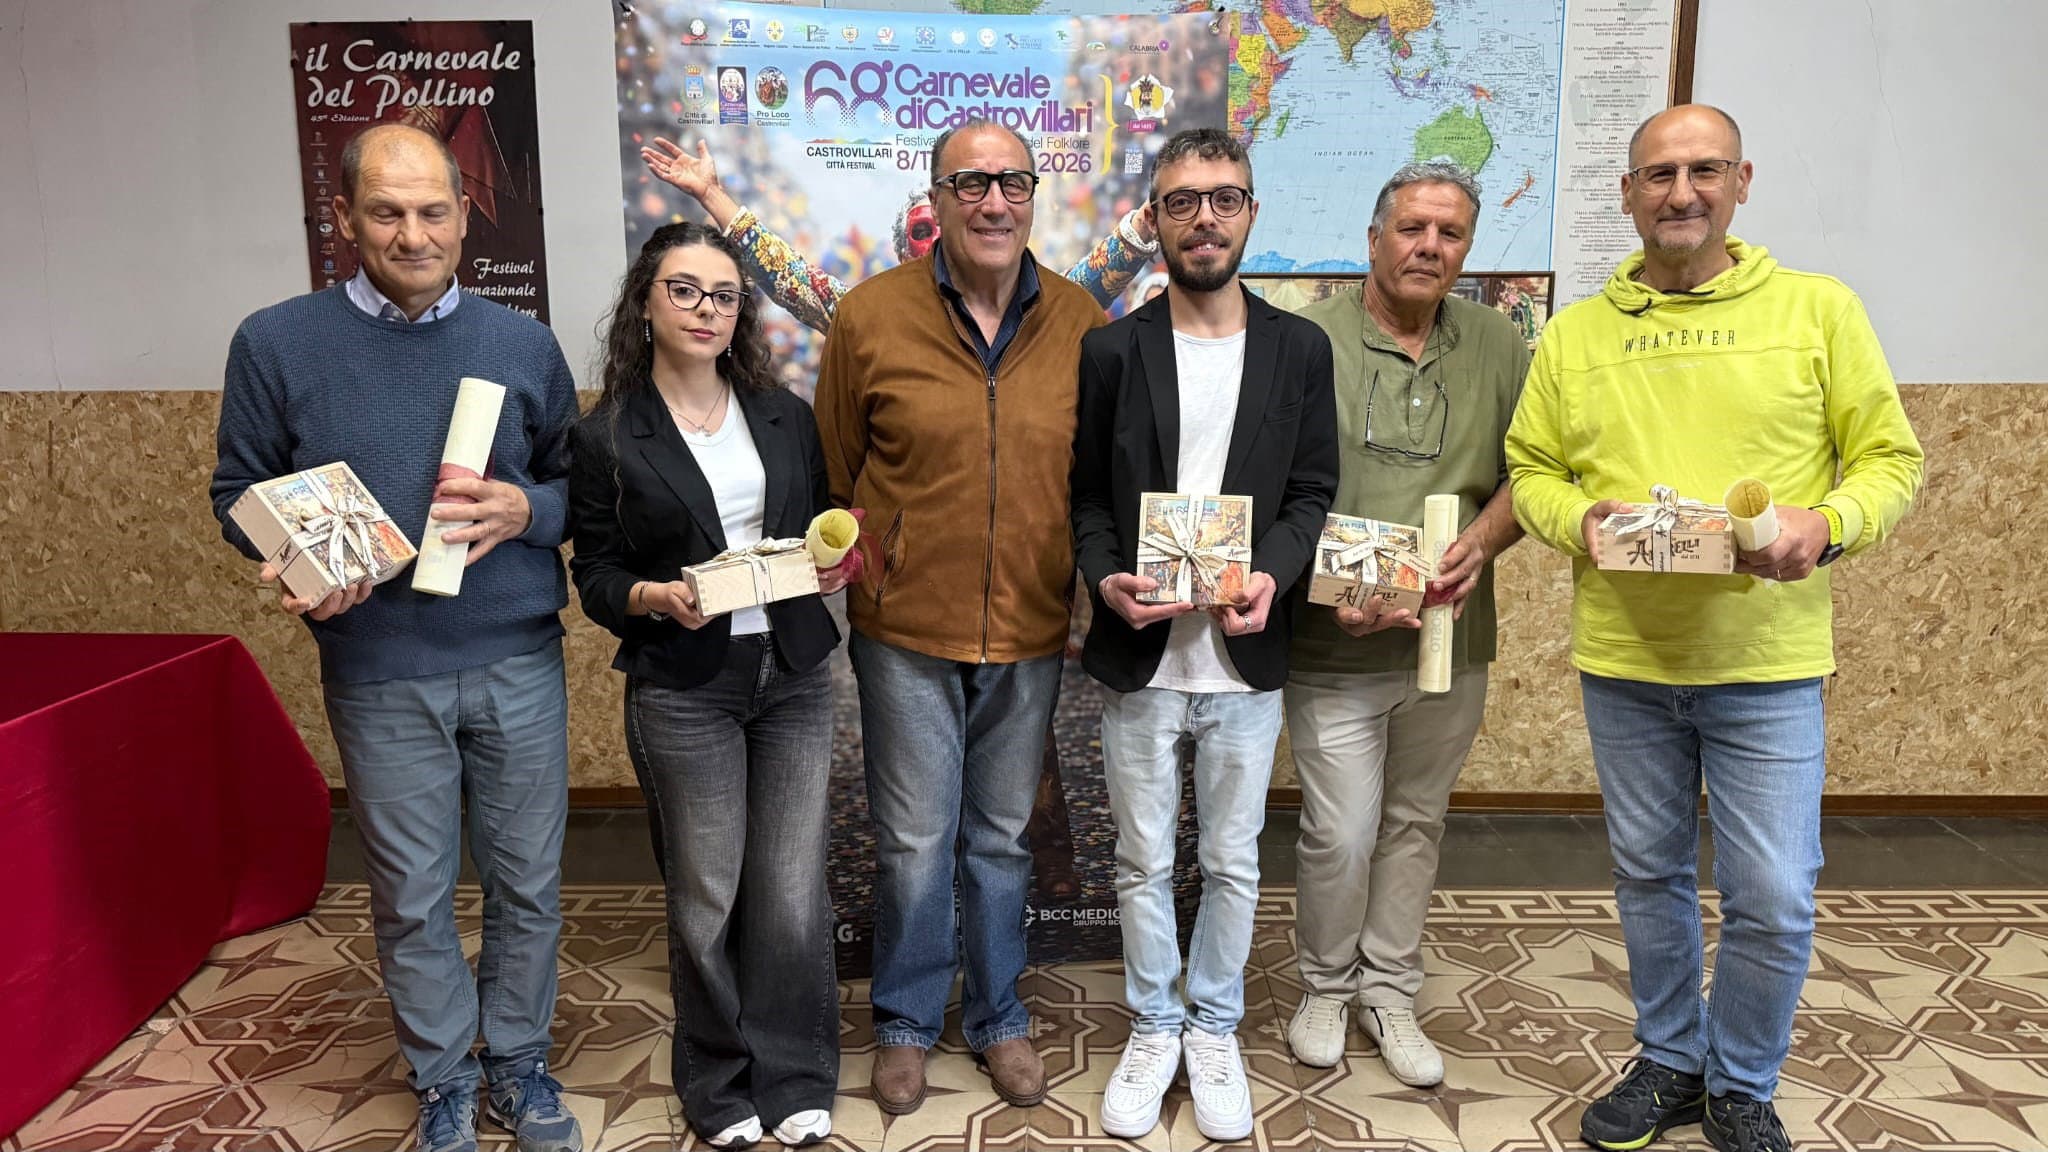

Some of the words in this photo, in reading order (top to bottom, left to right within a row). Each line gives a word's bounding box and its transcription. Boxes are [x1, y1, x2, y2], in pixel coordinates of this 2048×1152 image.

[305, 43, 329, 72] il
[343, 39, 521, 72] Carnevale
[894, 63, 1050, 99] Carnevale
[307, 76, 355, 108] del
[366, 74, 495, 119] Pollino
[806, 146, 893, 158] CASTROVILLARI
[1047, 136, 1090, 149] Folklore
[826, 160, 845, 169] CITTÀ
[846, 162, 877, 170] FESTIVAL
[1038, 152, 1091, 173] 2026
[473, 258, 535, 280] Festival
[1625, 329, 1736, 353] WHATEVER
